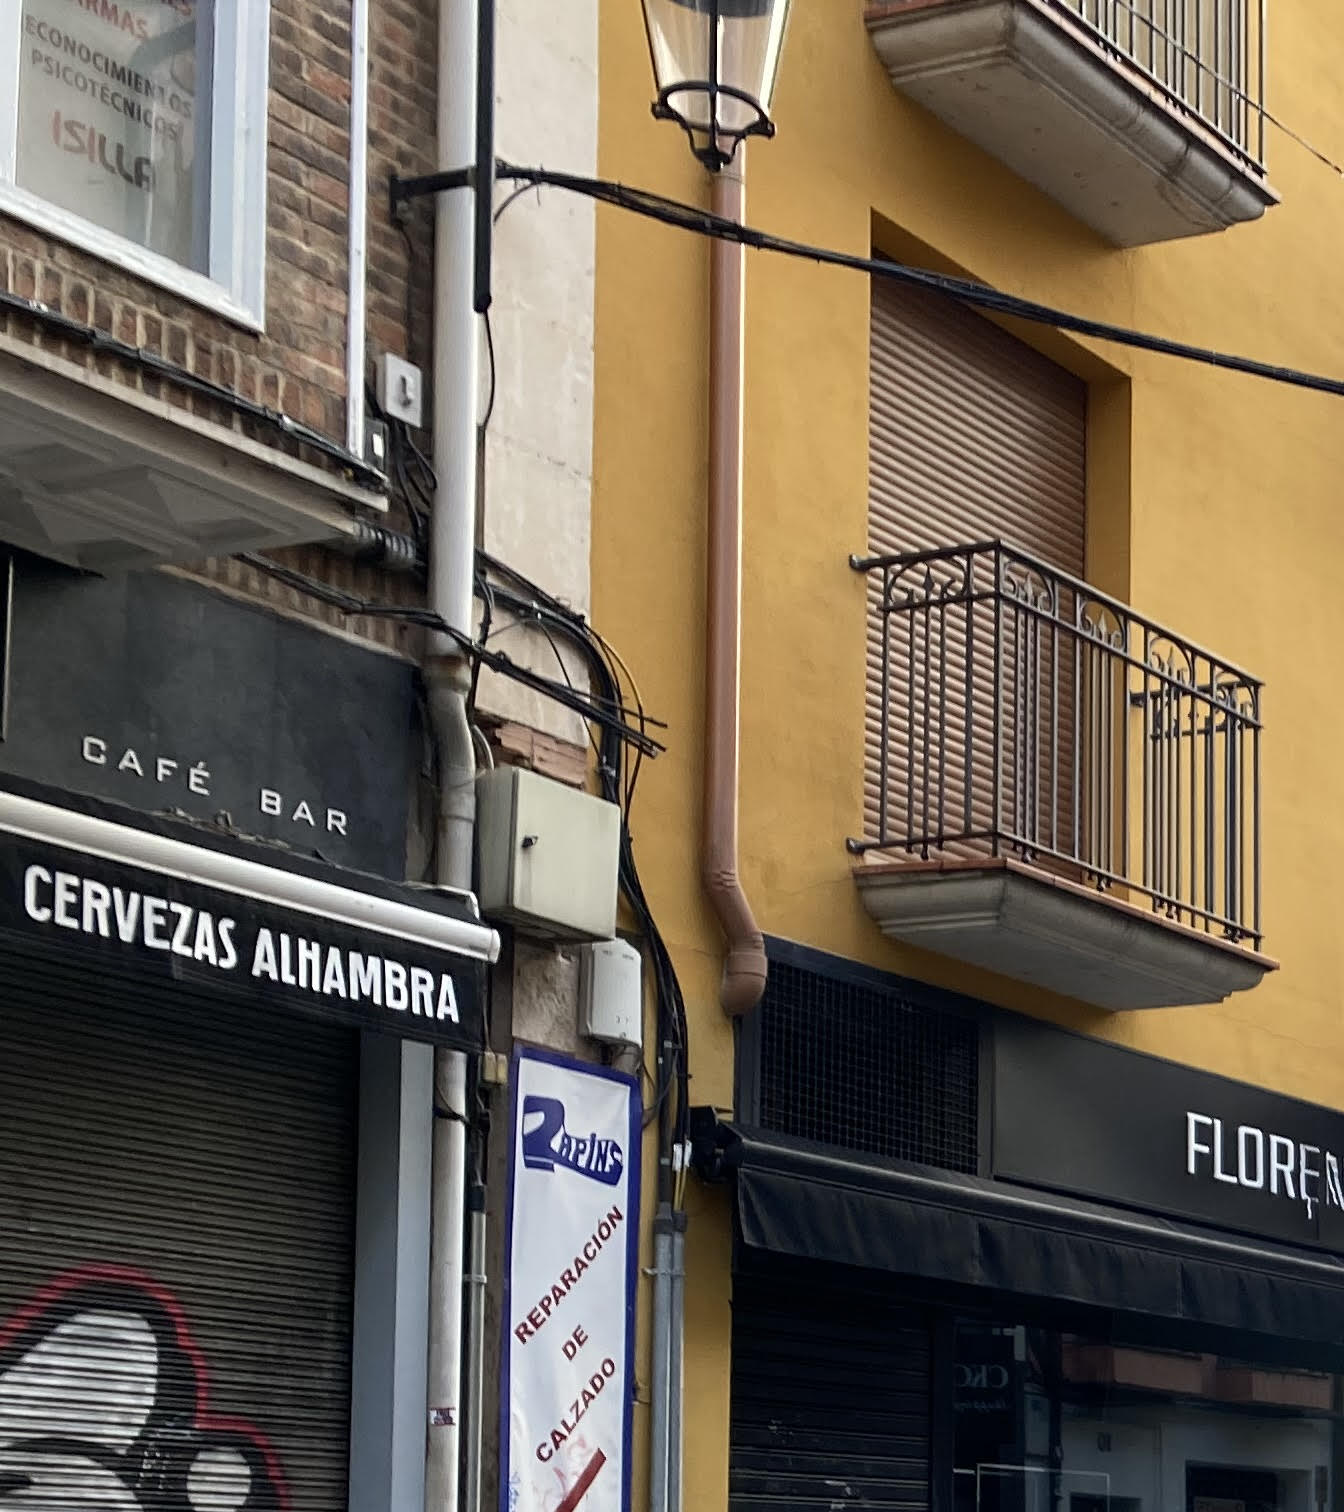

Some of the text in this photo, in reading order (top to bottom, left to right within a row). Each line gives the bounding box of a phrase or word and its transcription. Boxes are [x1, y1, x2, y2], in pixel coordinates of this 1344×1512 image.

[76, 0, 149, 41] RMAS
[82, 735, 347, 836] CAFÉ BAR
[24, 864, 460, 1024] CERVEZAS ALHAMBRA
[514, 1205, 624, 1345] REPARACIÓN
[561, 1324, 589, 1361] DE
[535, 1357, 617, 1463] CALZADO
